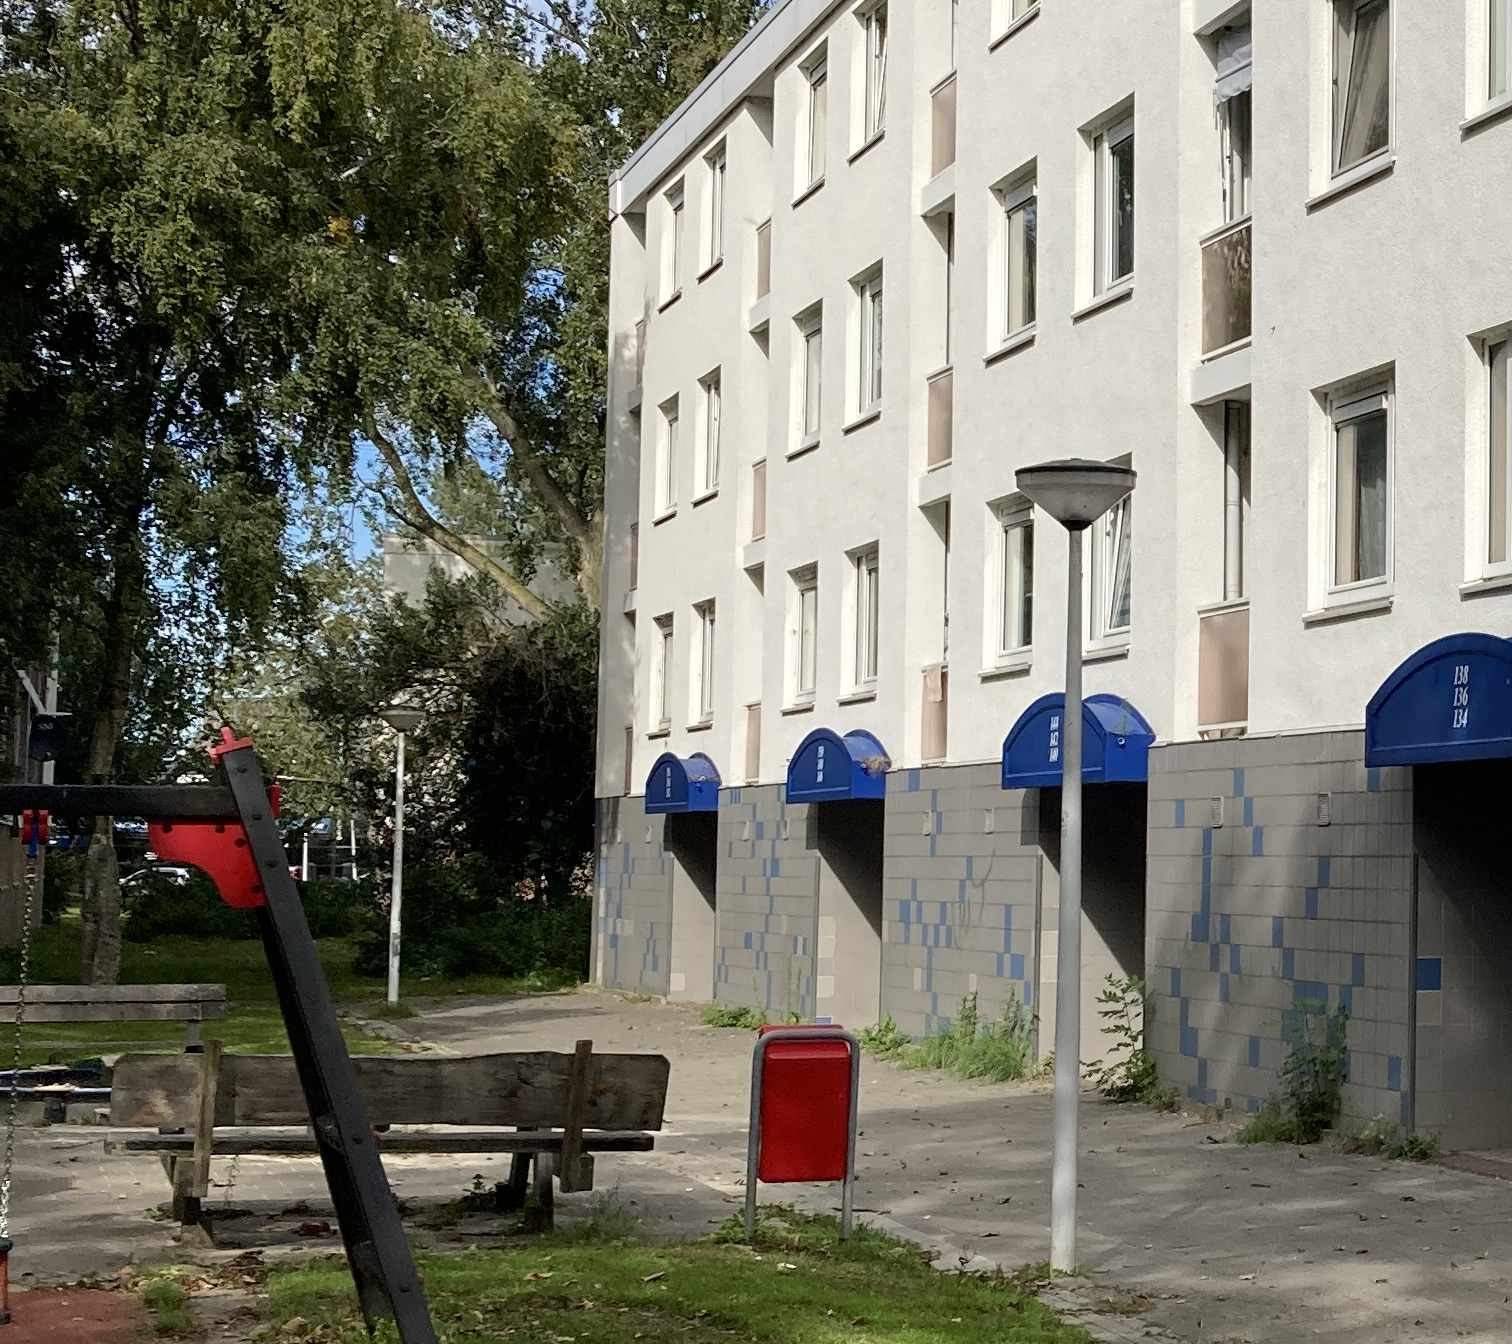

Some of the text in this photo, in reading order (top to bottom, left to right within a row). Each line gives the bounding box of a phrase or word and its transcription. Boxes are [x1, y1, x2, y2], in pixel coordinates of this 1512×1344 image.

[1453, 665, 1470, 685] 138
[1453, 686, 1469, 706] 136
[1453, 707, 1469, 728] 134
